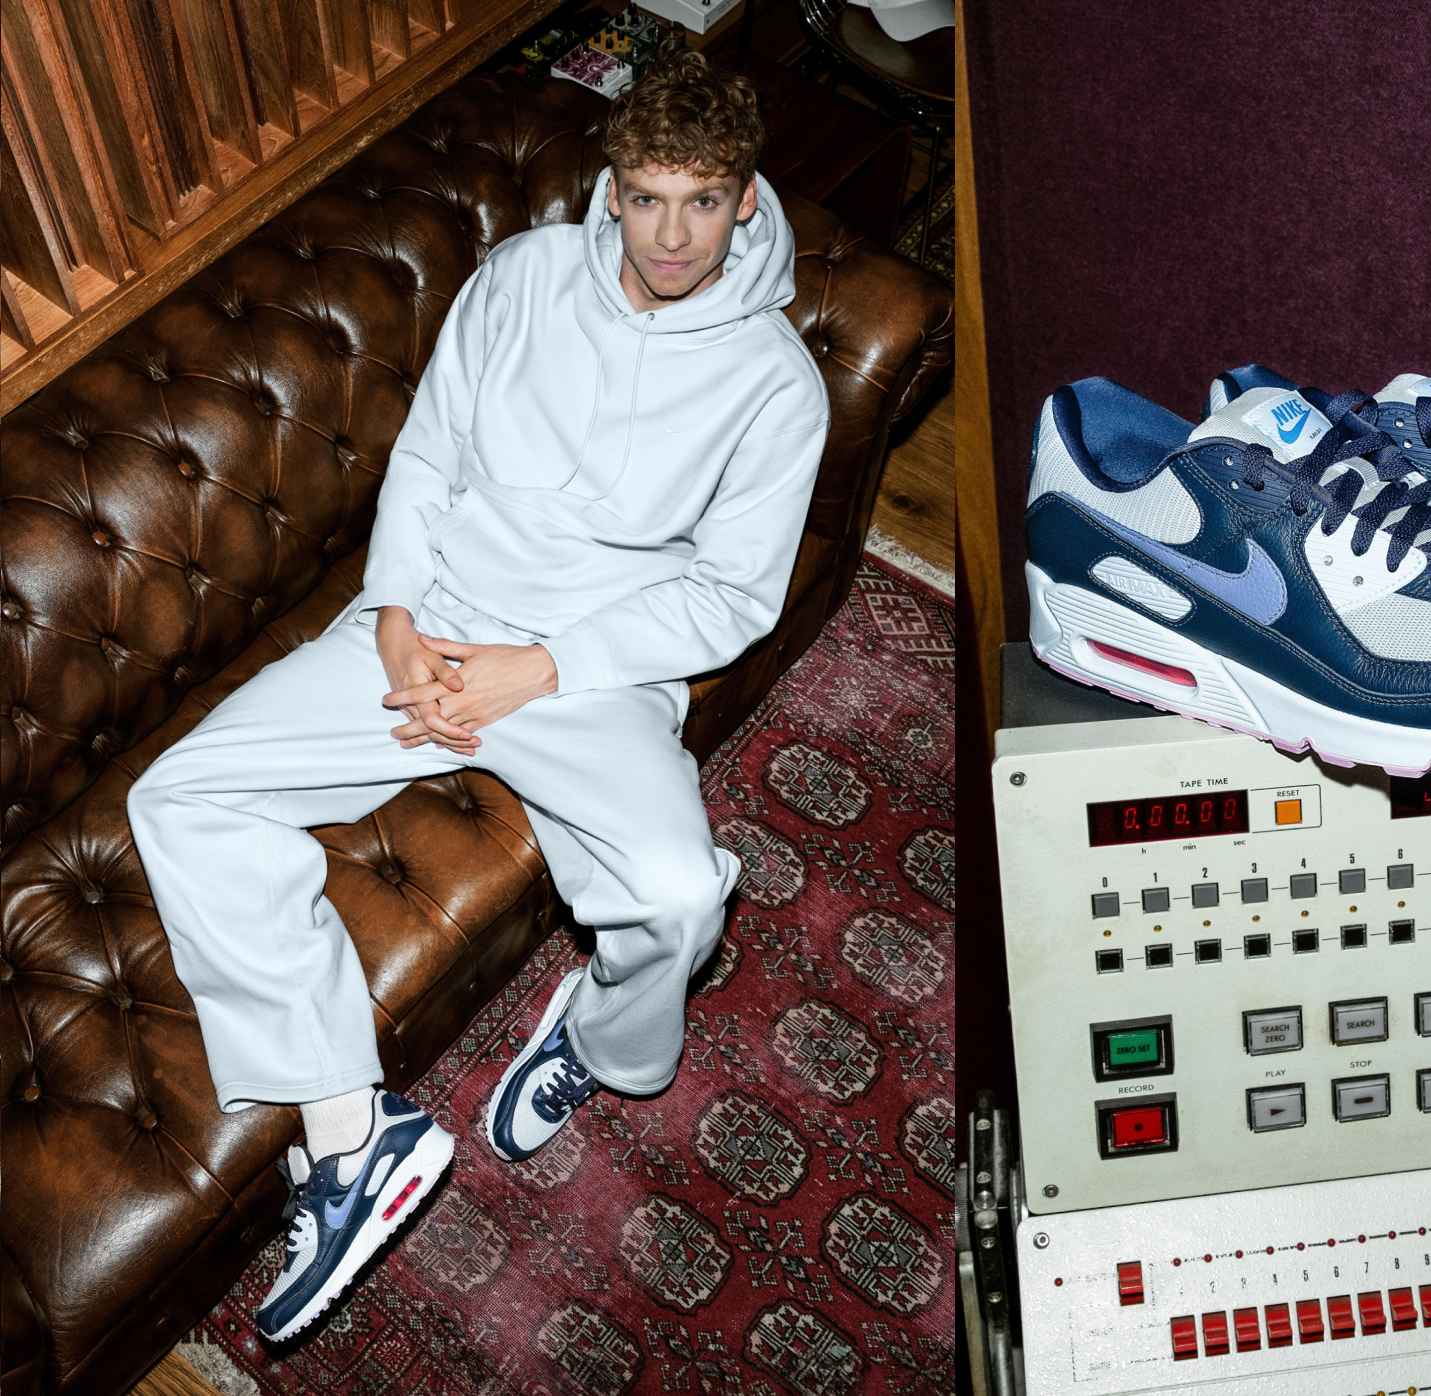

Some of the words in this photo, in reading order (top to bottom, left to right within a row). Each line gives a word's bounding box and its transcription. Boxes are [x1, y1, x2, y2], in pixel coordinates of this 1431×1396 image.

[1271, 399, 1307, 425] NIKE
[1180, 779, 1202, 788] TAPE
[1207, 777, 1229, 786] TIME
[1276, 789, 1300, 798] RESET
[1102, 876, 1108, 888] 0
[1153, 872, 1158, 884] 1
[1202, 867, 1208, 879] 2
[1251, 862, 1258, 874] 3
[1300, 857, 1307, 869] 4
[1349, 853, 1355, 864] 5
[1397, 848, 1404, 860] 6
[1261, 1024, 1290, 1034] SEARCH
[1346, 1019, 1375, 1029] SEARCH
[1265, 1034, 1286, 1043] ZERO
[1117, 1045, 1137, 1055] ZERO
[1138, 1043, 1151, 1052] SET
[1350, 1060, 1373, 1069] STOP
[1265, 1069, 1286, 1078] PLAY
[1118, 1083, 1155, 1095] RECORD
[1303, 1269, 1310, 1282] 5
[1333, 1265, 1340, 1278] 6
[1364, 1261, 1371, 1273] 7
[1394, 1257, 1400, 1270] 8
[1424, 1253, 1431, 1265] 9
